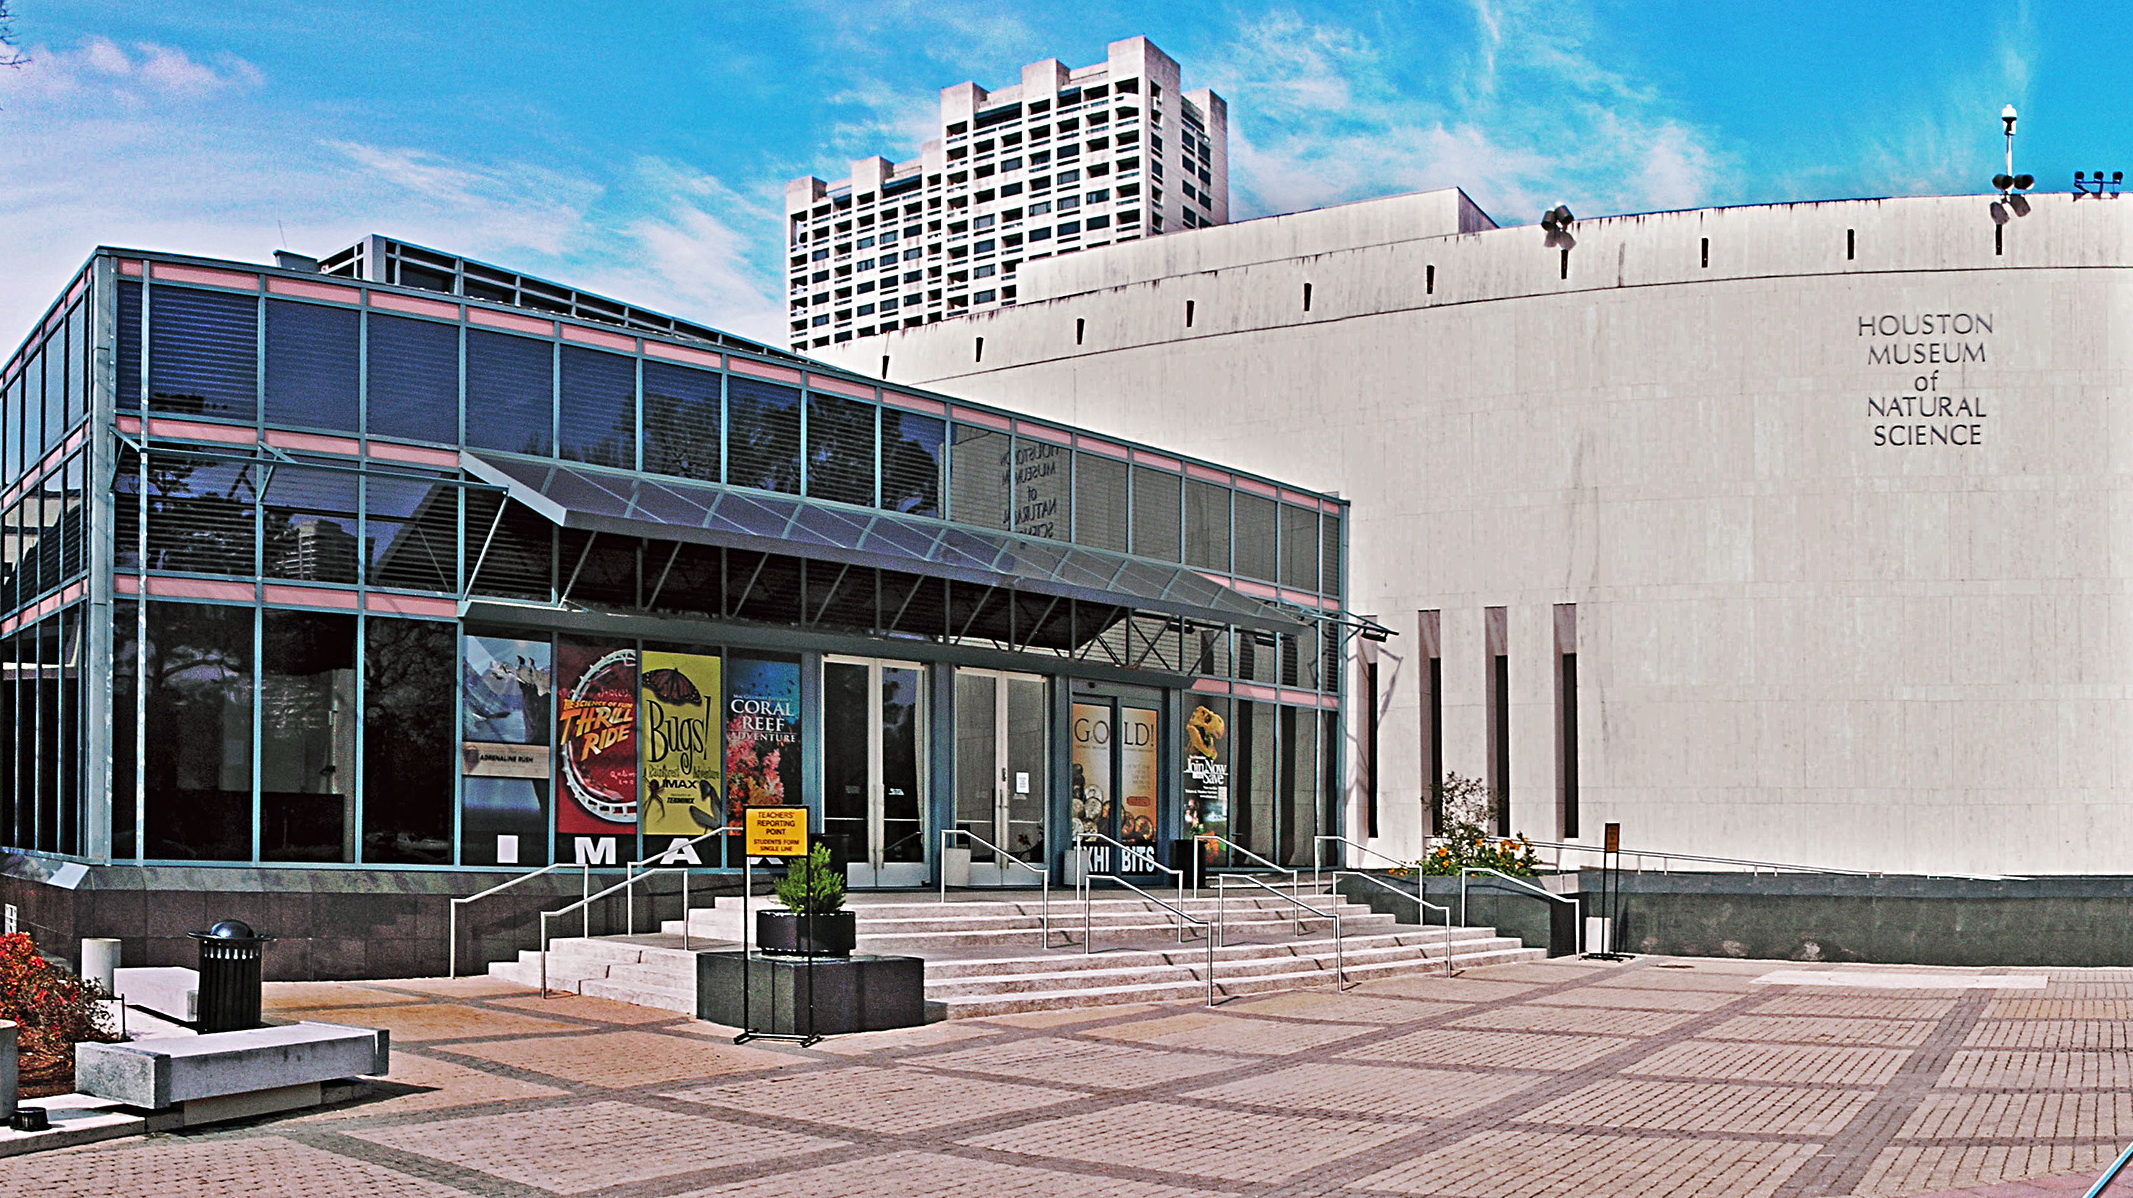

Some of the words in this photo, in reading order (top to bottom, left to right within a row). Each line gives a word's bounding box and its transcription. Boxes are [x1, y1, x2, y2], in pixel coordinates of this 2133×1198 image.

[1858, 313, 1993, 336] HOUSTON
[1868, 342, 1986, 365] MUSEUM
[1914, 369, 1939, 391] of
[1868, 396, 1987, 417] NATURAL
[1874, 424, 1982, 446] SCIENCE
[731, 699, 794, 716] CORAL
[560, 707, 633, 745] THRILL
[742, 715, 784, 731] REEF
[581, 724, 631, 761] RIDE
[646, 695, 711, 775] Bugs!
[730, 732, 796, 742] ADVENTURE
[1204, 759, 1227, 774] Now
[662, 780, 697, 788] IMAX
[1203, 773, 1224, 784] Save
